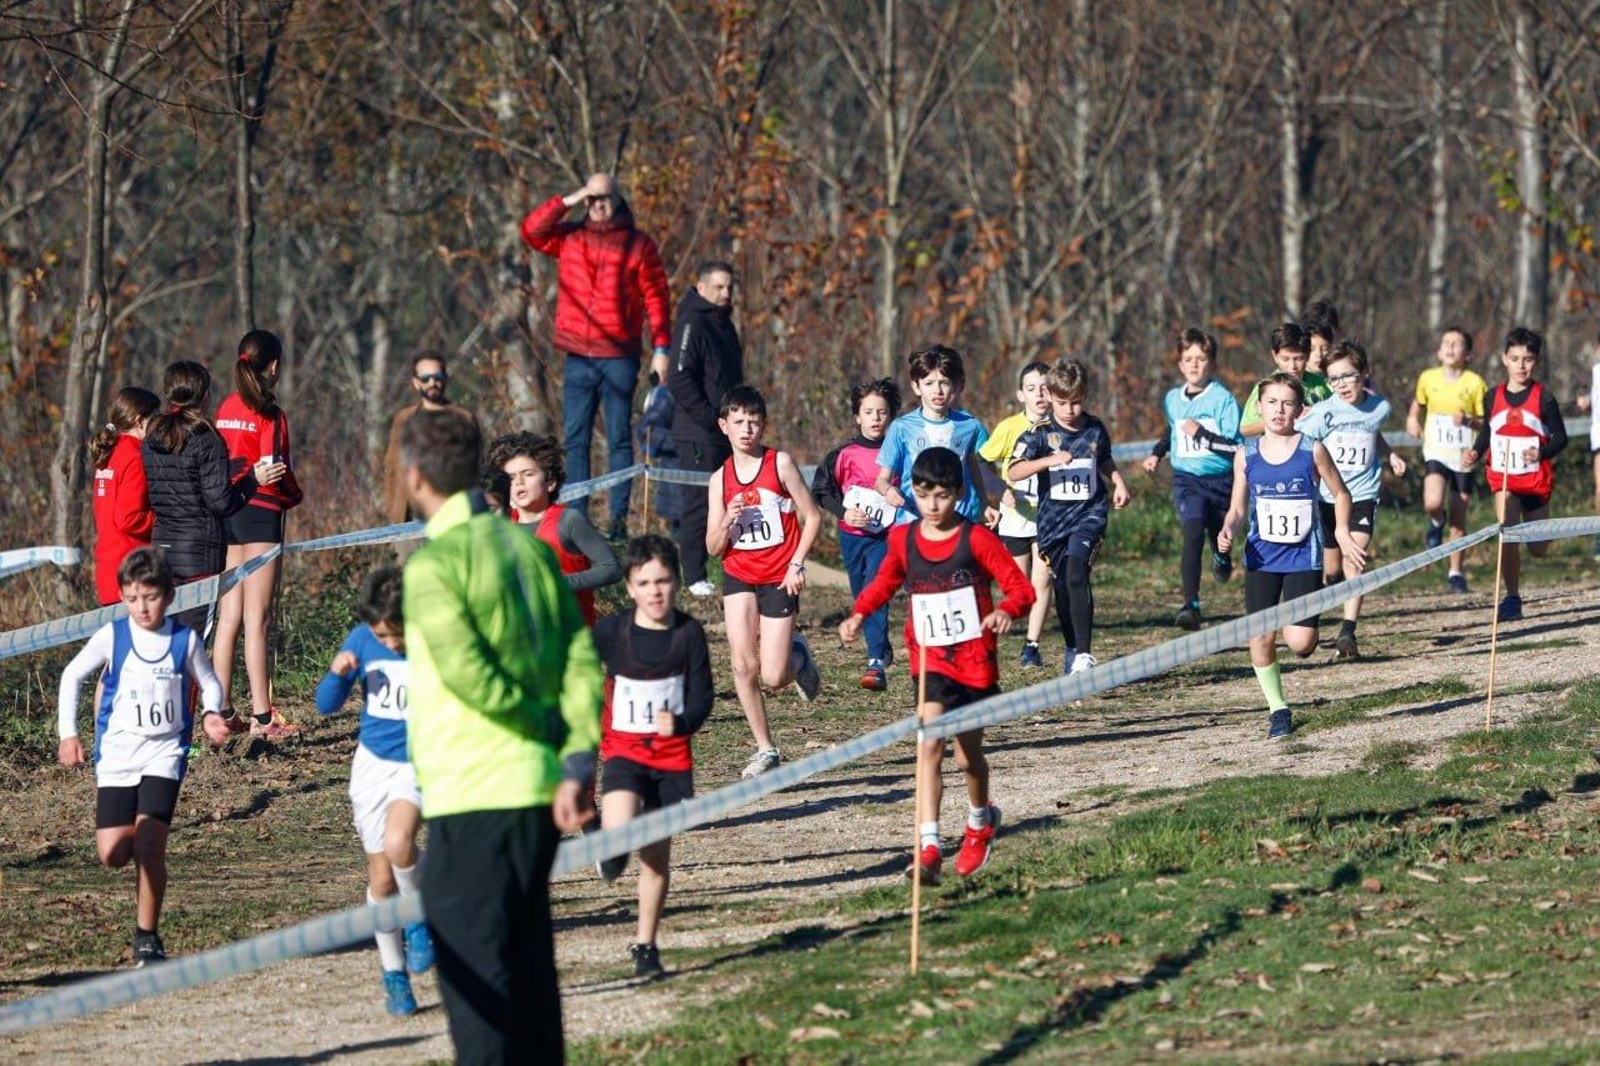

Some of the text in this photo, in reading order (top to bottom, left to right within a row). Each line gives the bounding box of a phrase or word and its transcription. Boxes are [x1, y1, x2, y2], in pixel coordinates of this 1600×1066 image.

[1438, 428, 1462, 443] 164
[1336, 446, 1366, 465] 221
[1061, 474, 1091, 494] 184
[734, 521, 771, 542] 210
[1267, 515, 1300, 536] 131
[927, 610, 966, 638] 145
[380, 684, 408, 711] 20
[135, 699, 175, 727] 160
